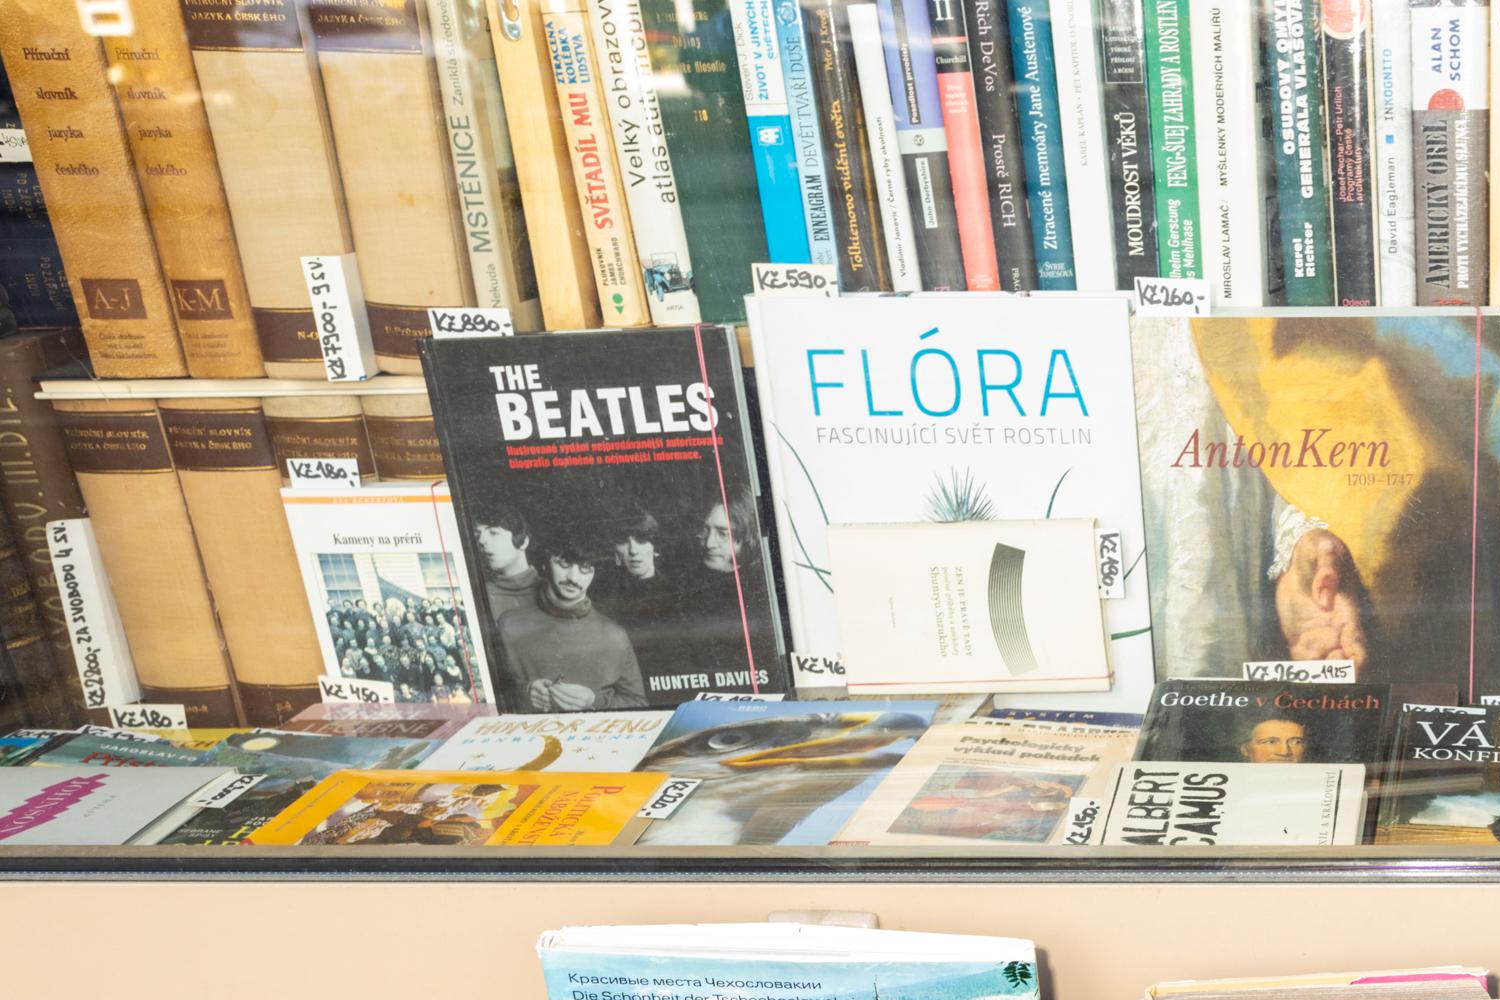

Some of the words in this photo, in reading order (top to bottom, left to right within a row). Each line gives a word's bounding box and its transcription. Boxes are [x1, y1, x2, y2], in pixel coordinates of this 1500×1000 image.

[975, 4, 990, 36] Rich
[1021, 6, 1039, 80] Austenové
[546, 21, 564, 84] ZTRACENÁ
[559, 27, 577, 84] KOLÉBKA
[572, 34, 591, 83] LIDSTVA
[936, 55, 966, 65] Churchill
[978, 39, 998, 92] DeVos
[1431, 27, 1442, 74] ALAN
[1449, 19, 1461, 81] SCHOM
[568, 92, 592, 126] MU
[1028, 81, 1041, 117] Jane
[992, 134, 1008, 179] Prostě
[1034, 120, 1049, 188] memoáry
[1114, 111, 1136, 158] VĚKŮ
[1422, 119, 1449, 176] OREL
[451, 115, 493, 252] MSTĚNICE
[569, 134, 614, 230] SVĚTADÍL
[999, 181, 1016, 228] RICH
[842, 186, 863, 272] Tolkienovo
[1041, 189, 1058, 250] Ztracené
[1124, 162, 1144, 256] MOUDROST
[1293, 238, 1305, 278] Karel
[1304, 222, 1316, 278] Richter
[1423, 184, 1451, 288] AMERICKÝ
[489, 364, 542, 391] THE
[806, 327, 1090, 417] FLÓRA
[495, 382, 719, 441] BEATLES
[816, 423, 937, 446] FASCINUJÍCÍ
[945, 423, 995, 445] SVĚT
[1004, 426, 1091, 445] ROSTLIN
[332, 532, 376, 548] Kameny
[377, 535, 391, 546] na
[392, 532, 423, 548] prérii
[649, 673, 710, 692] HUNTER
[716, 669, 769, 687] DAVIES
[1160, 690, 1249, 709] Goethe
[1255, 696, 1271, 709] v
[1274, 689, 1380, 710] Čechách
[953, 746, 1017, 759] výklad
[1019, 748, 1101, 763] pohádek
[959, 735, 1085, 753] Psychologický
[1169, 772, 1230, 847] CAMUS
[567, 972, 650, 990] Красивые
[652, 976, 702, 990] места
[705, 977, 823, 992] Чехословакии
